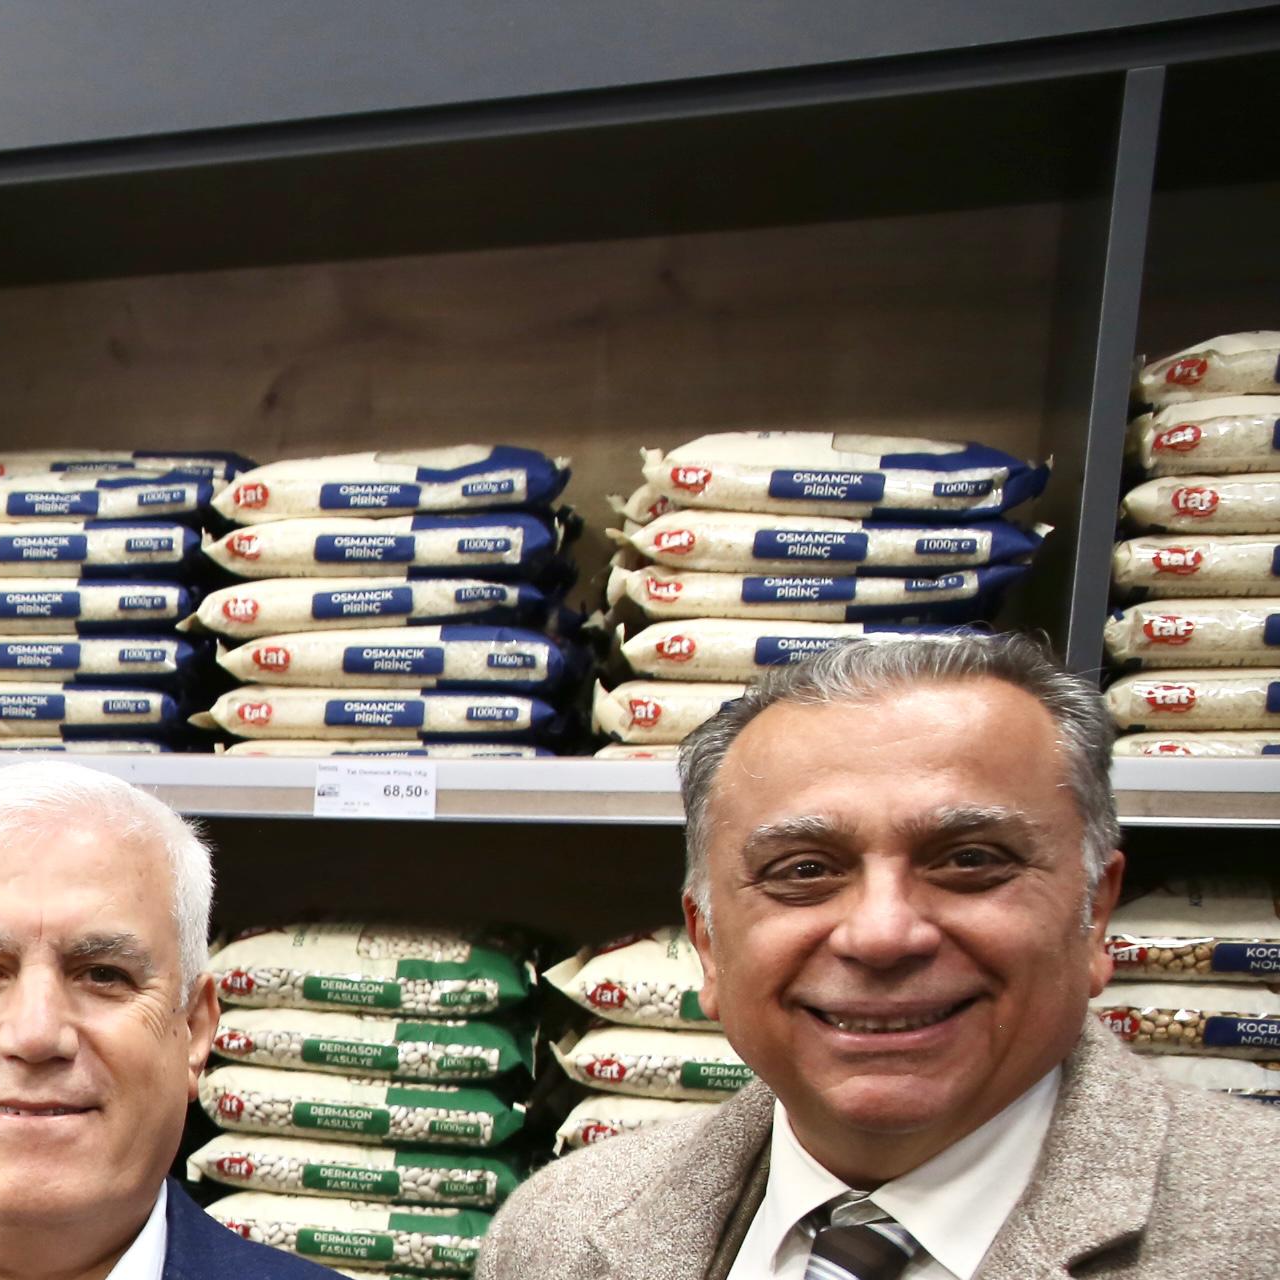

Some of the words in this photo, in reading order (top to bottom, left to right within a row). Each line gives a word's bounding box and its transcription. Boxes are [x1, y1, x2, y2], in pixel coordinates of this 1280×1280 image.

[793, 472, 863, 485] OSMANCIK
[340, 485, 401, 495] OSMANCIK
[803, 484, 848, 498] PİRİNÇ
[25, 492, 81, 502] OSMANCIK
[350, 494, 388, 507] PİRİNÇ
[1178, 487, 1213, 511] tat
[35, 501, 70, 514] PİRİNÇ
[13, 537, 70, 547] OSMANCIK
[334, 536, 396, 547] OSMANCIK
[776, 532, 846, 545] OSMANCIK
[23, 545, 58, 558] PİRİNÇ
[345, 546, 383, 560] PİRİNÇ
[787, 544, 831, 558] PİRİNÇ
[764, 577, 834, 587] OSMANCIK
[6, 593, 63, 603] OSMANCIK
[331, 590, 393, 603] OSMANCIK
[776, 586, 820, 599] PİRİNÇ
[16, 602, 51, 615] PİRİNÇ
[343, 601, 381, 614] PİRİNÇ
[7, 645, 64, 654] OSMANCIK
[778, 639, 840, 650] OSMANC
[16, 653, 51, 666] PİRİNÇ
[363, 648, 424, 659] OSMANCIK
[374, 658, 412, 671] PİRİNÇ
[2, 705, 37, 717] PİRİNÇ
[344, 702, 406, 712] OSMANCIK
[355, 711, 393, 724] PİRİNÇ
[320, 980, 384, 994] DERMASON
[327, 992, 375, 1004] FASULYE
[597, 989, 619, 1003] tat
[1237, 1022, 1280, 1035] KOÇB
[319, 1043, 382, 1057] DERMASON
[325, 1054, 374, 1067] FASULYE
[594, 1063, 619, 1078] tat
[700, 1066, 754, 1078] DERMAS
[310, 1106, 372, 1120] DERMASON
[317, 1117, 364, 1129] FASULYE
[320, 1168, 382, 1182] DERMASON
[326, 1179, 374, 1192] FASULYE
[314, 1233, 376, 1246] DERMASON
[320, 1244, 367, 1257] FASULYE
